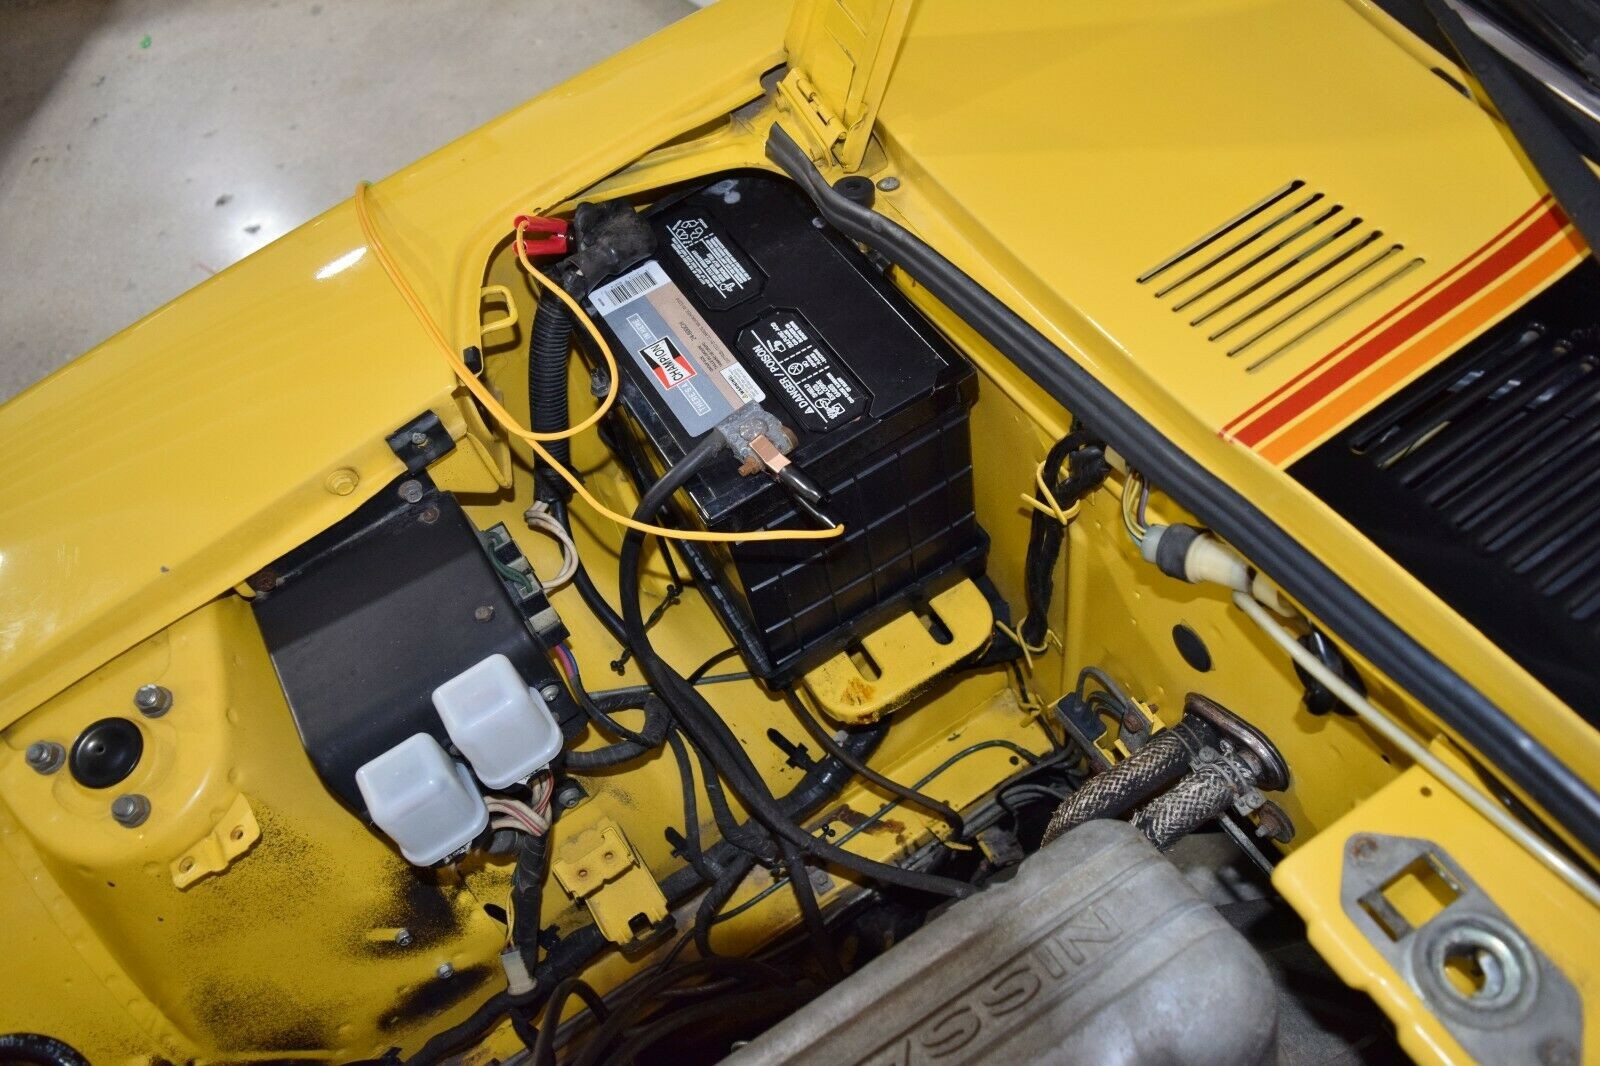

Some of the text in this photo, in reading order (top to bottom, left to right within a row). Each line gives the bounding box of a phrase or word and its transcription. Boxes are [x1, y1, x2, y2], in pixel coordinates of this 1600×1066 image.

[650, 344, 684, 382] CHAMPION
[752, 344, 780, 373] POISON
[778, 377, 809, 408] DANGER
